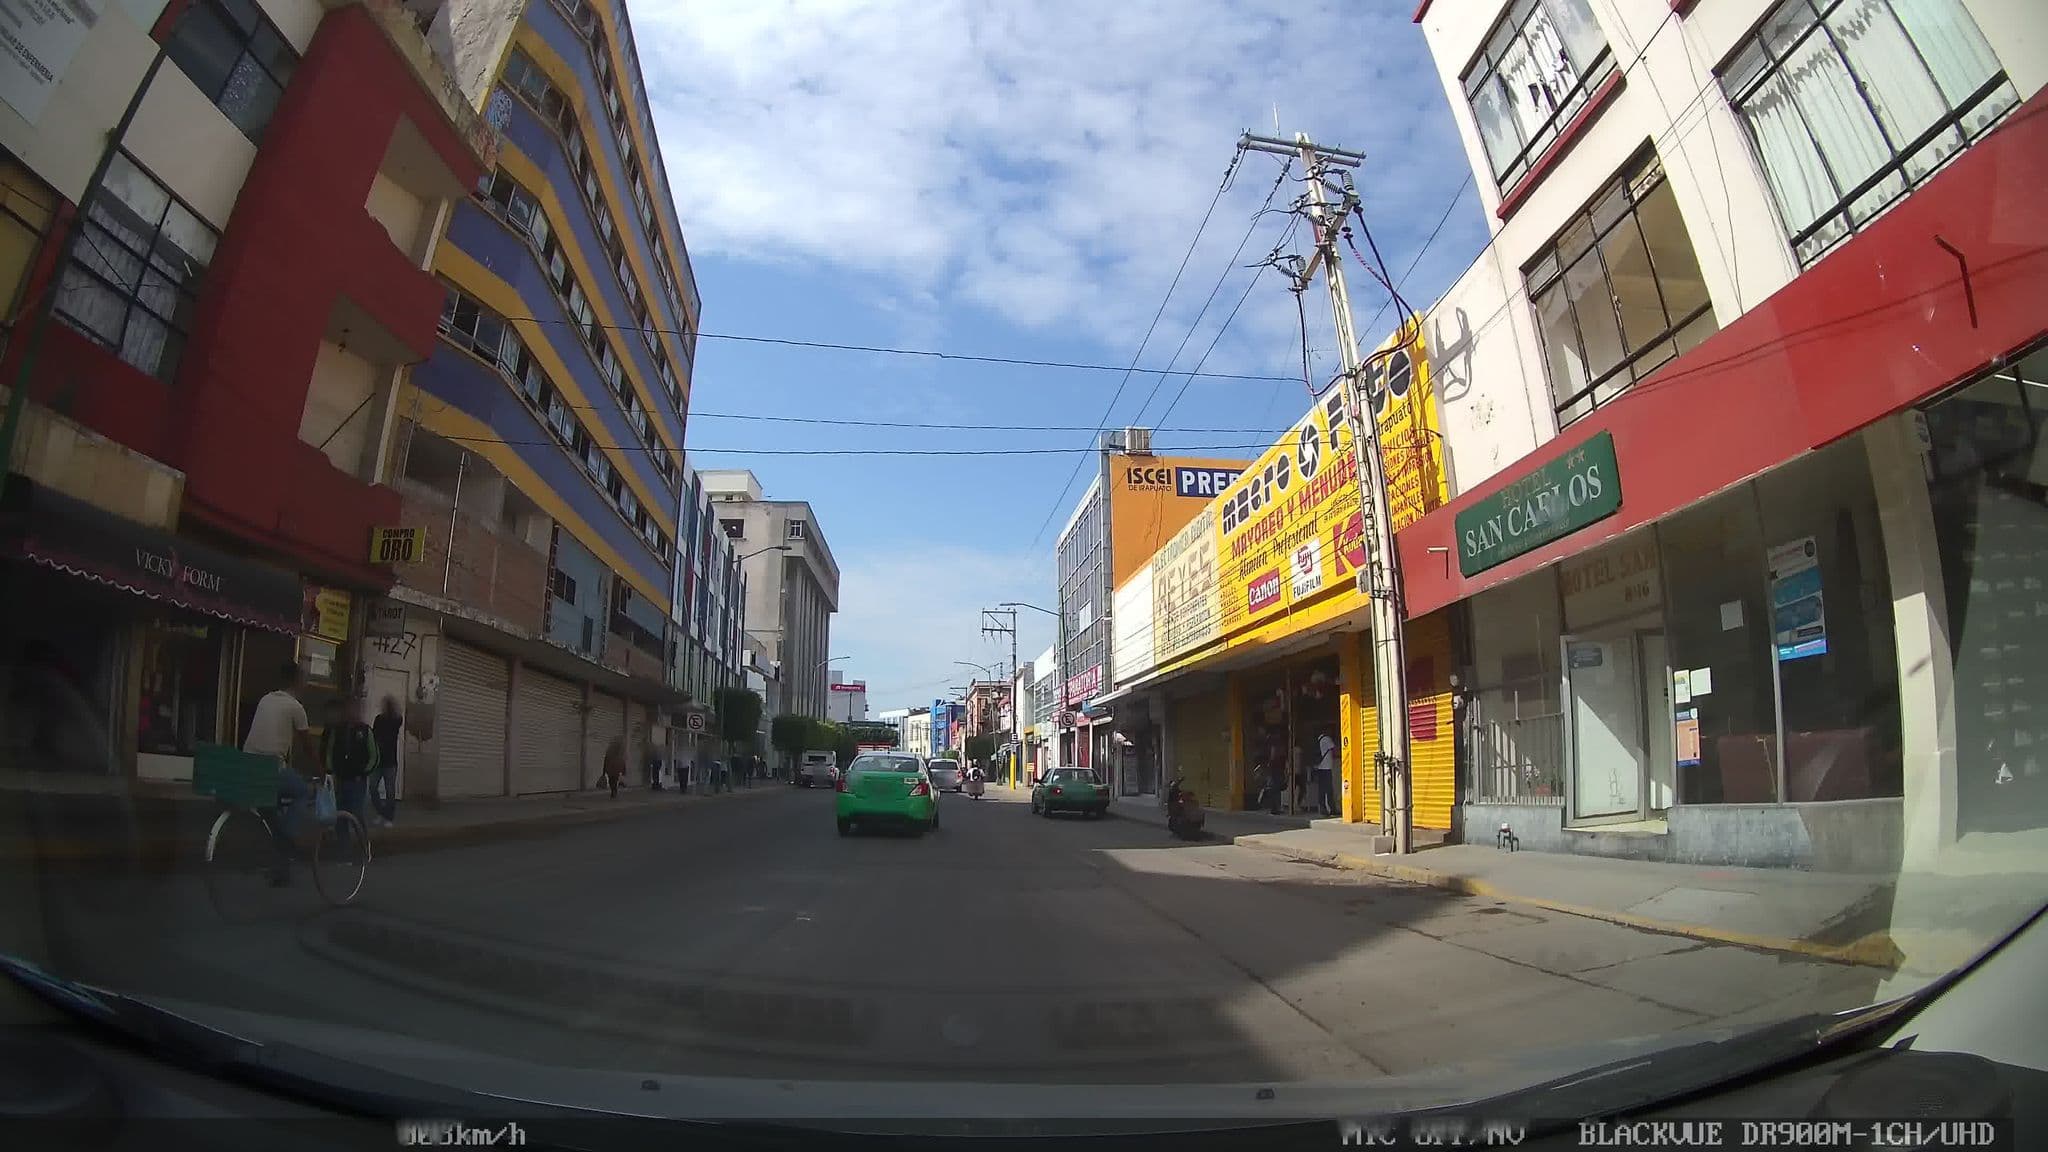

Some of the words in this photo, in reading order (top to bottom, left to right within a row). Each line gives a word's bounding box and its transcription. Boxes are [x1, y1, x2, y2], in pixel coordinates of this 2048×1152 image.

[1127, 467, 1172, 485] ISCEI
[1139, 484, 1172, 492] IRAPUATO
[1232, 506, 1284, 560] MAYOREO
[1287, 496, 1294, 522] Y
[1299, 450, 1356, 514] MENUDE
[383, 528, 415, 539] COMPRO
[1466, 515, 1504, 557] SAN
[380, 538, 413, 561] ORO
[136, 547, 173, 577] VICKY
[183, 565, 221, 593] FORM
[1249, 577, 1279, 606] Canon
[1293, 575, 1321, 598] FUJIFILM
